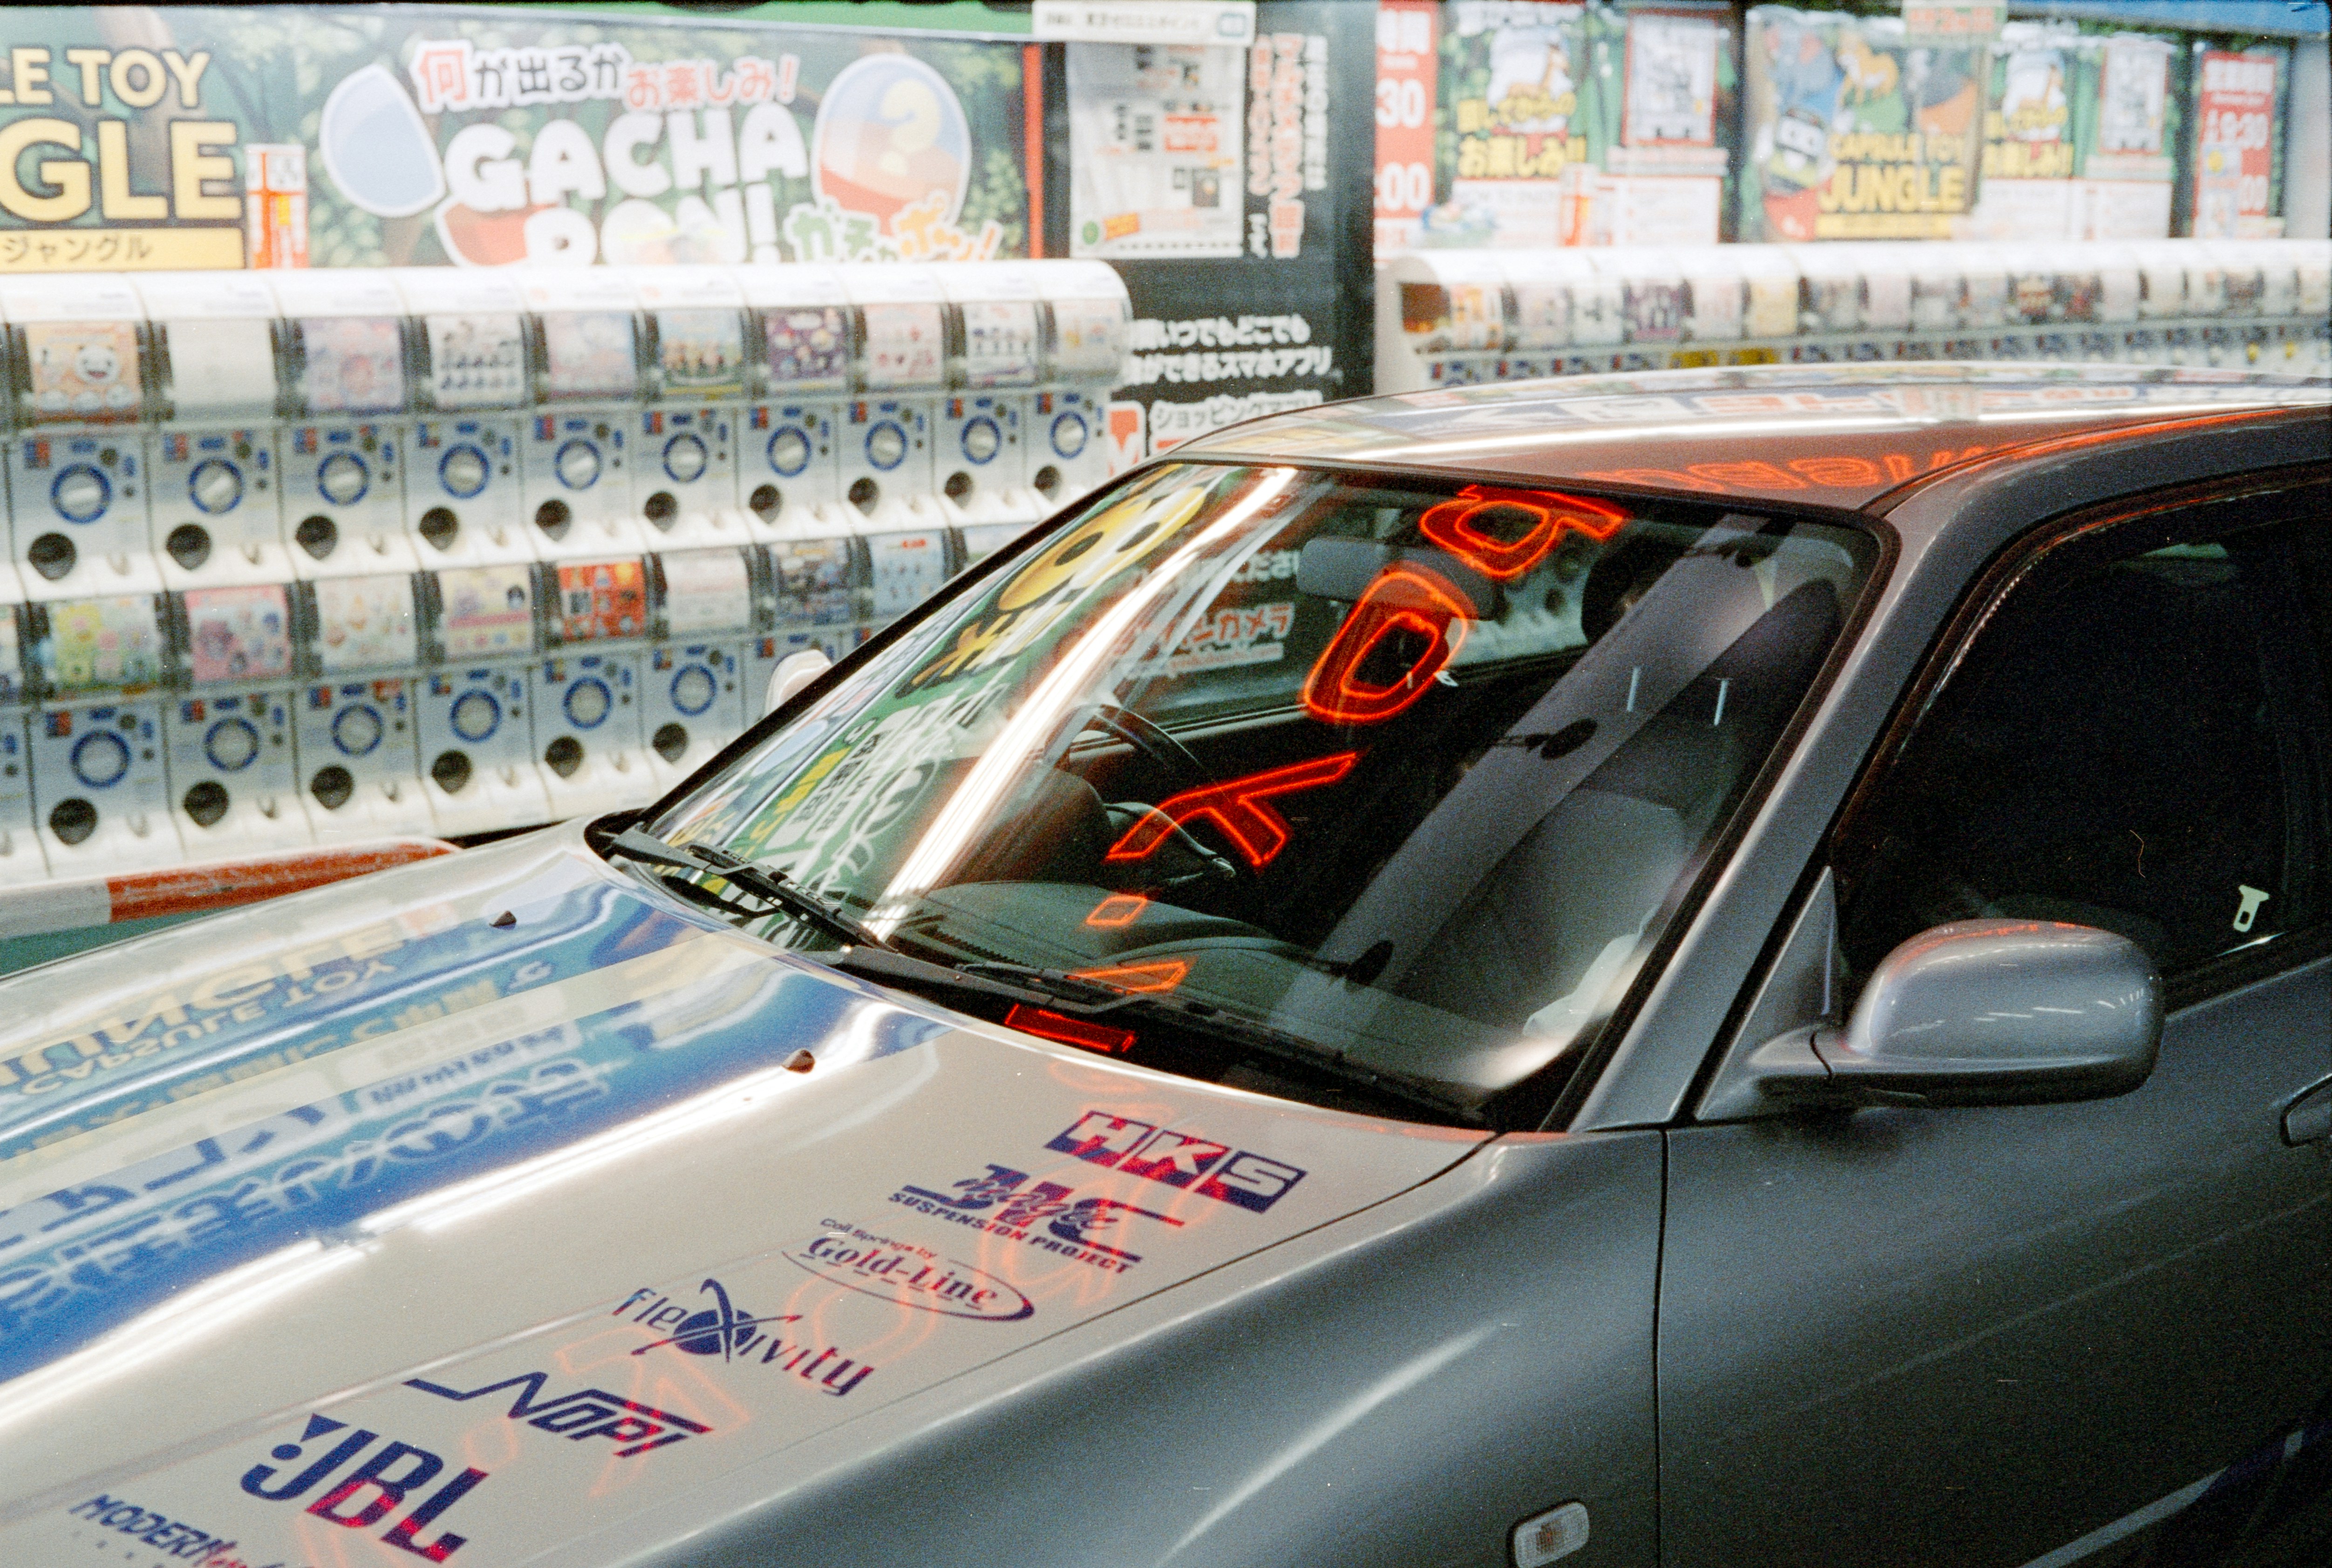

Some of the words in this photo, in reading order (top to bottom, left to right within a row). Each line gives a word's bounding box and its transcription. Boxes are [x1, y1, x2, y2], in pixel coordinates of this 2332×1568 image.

[65, 48, 211, 108] TOY
[0, 116, 243, 223] GLE
[444, 99, 809, 211] GACHA
[1818, 165, 1967, 213] JUNGLE
[4, 234, 154, 266] ジャングル
[1043, 1110, 1309, 1214] HKS
[807, 1236, 1000, 1304] Gold-Line
[887, 1191, 1029, 1242] SUSPENSION
[1029, 1235, 1135, 1275] PROJECT
[239, 1428, 490, 1565] JBL
